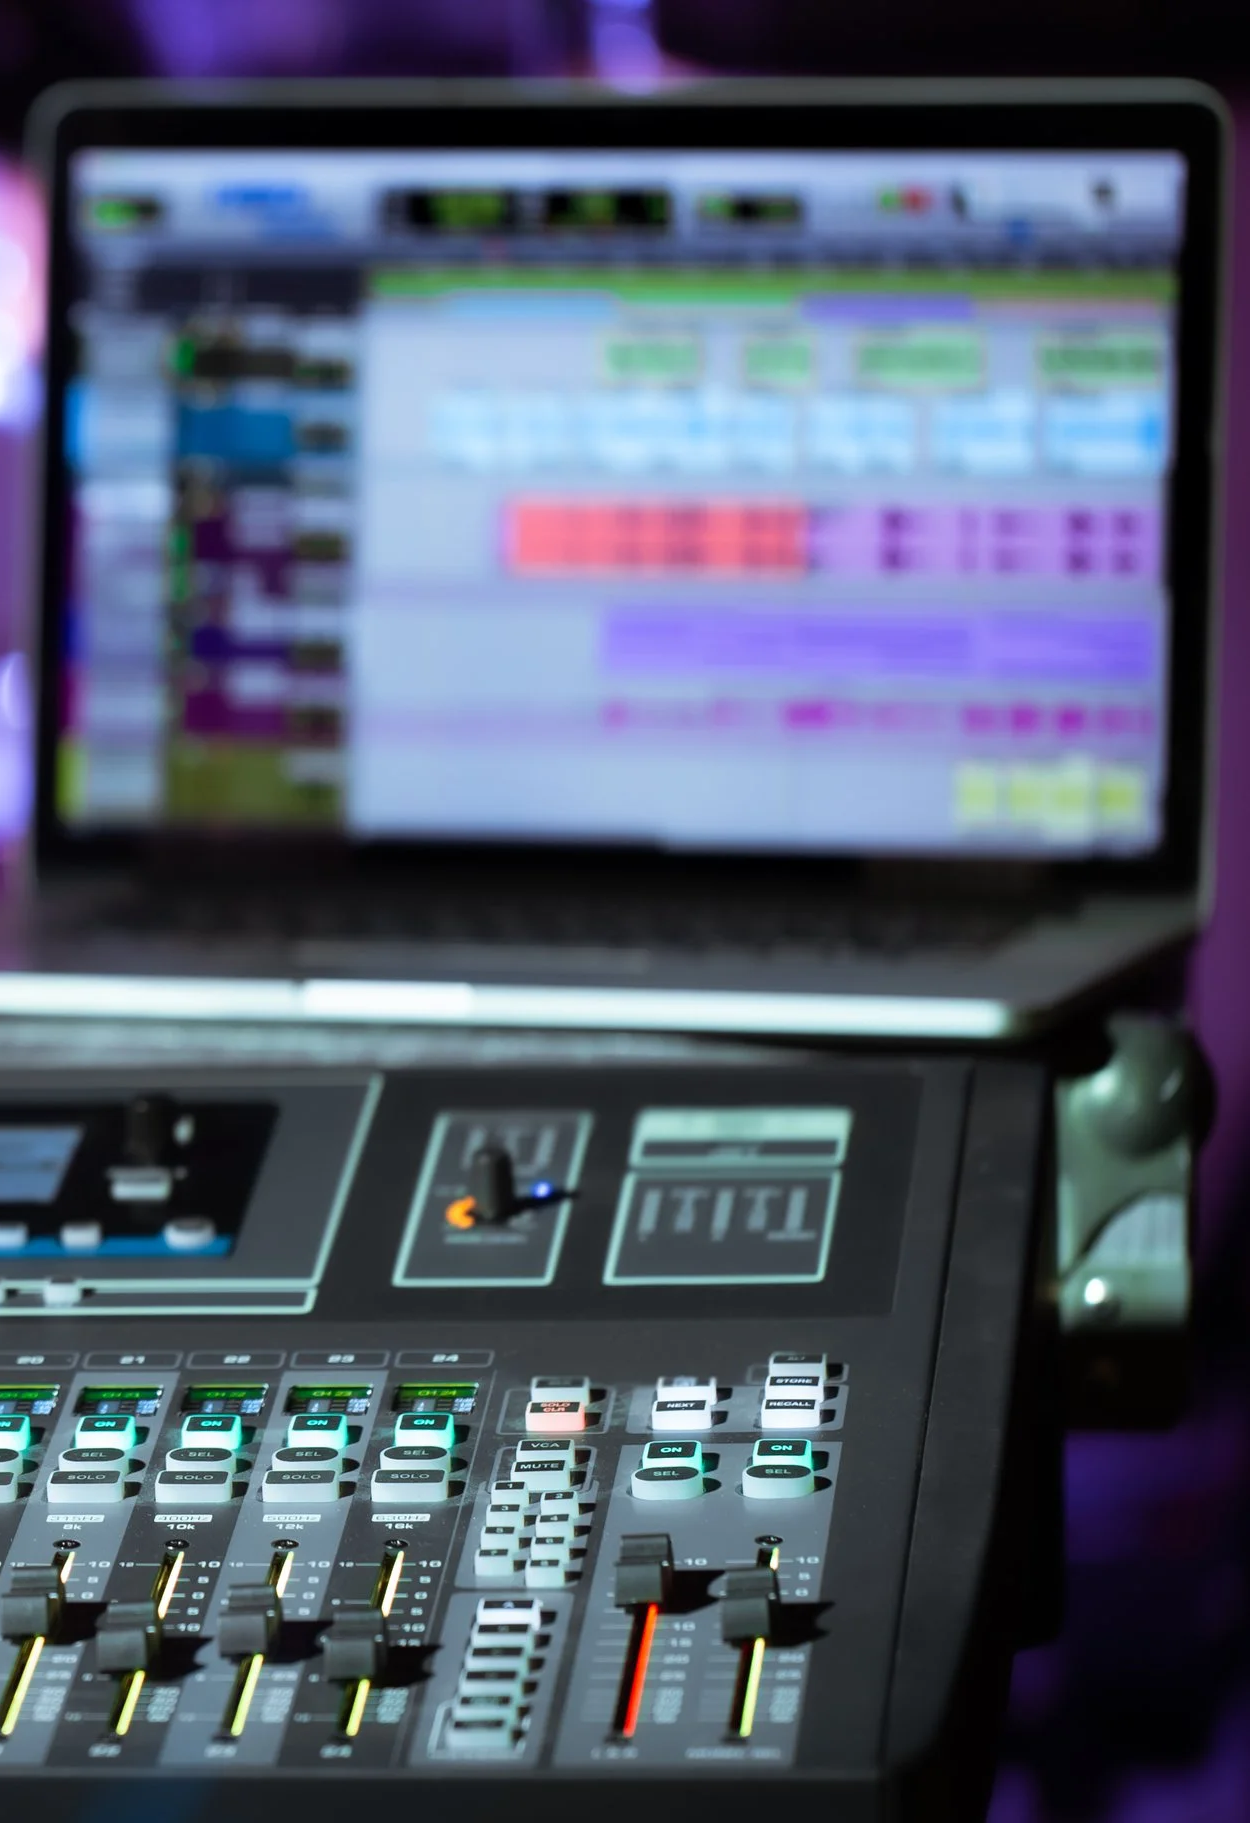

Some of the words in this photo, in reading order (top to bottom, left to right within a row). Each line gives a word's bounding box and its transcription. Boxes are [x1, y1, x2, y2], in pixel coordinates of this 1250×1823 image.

[119, 1355, 145, 1365] 21
[431, 1354, 460, 1363] 24
[94, 1420, 117, 1428] ON
[200, 1419, 223, 1427] ON
[306, 1419, 329, 1427] ON
[412, 1418, 435, 1426] ON
[683, 1558, 708, 1566] 10
[795, 1556, 820, 1564] 10
